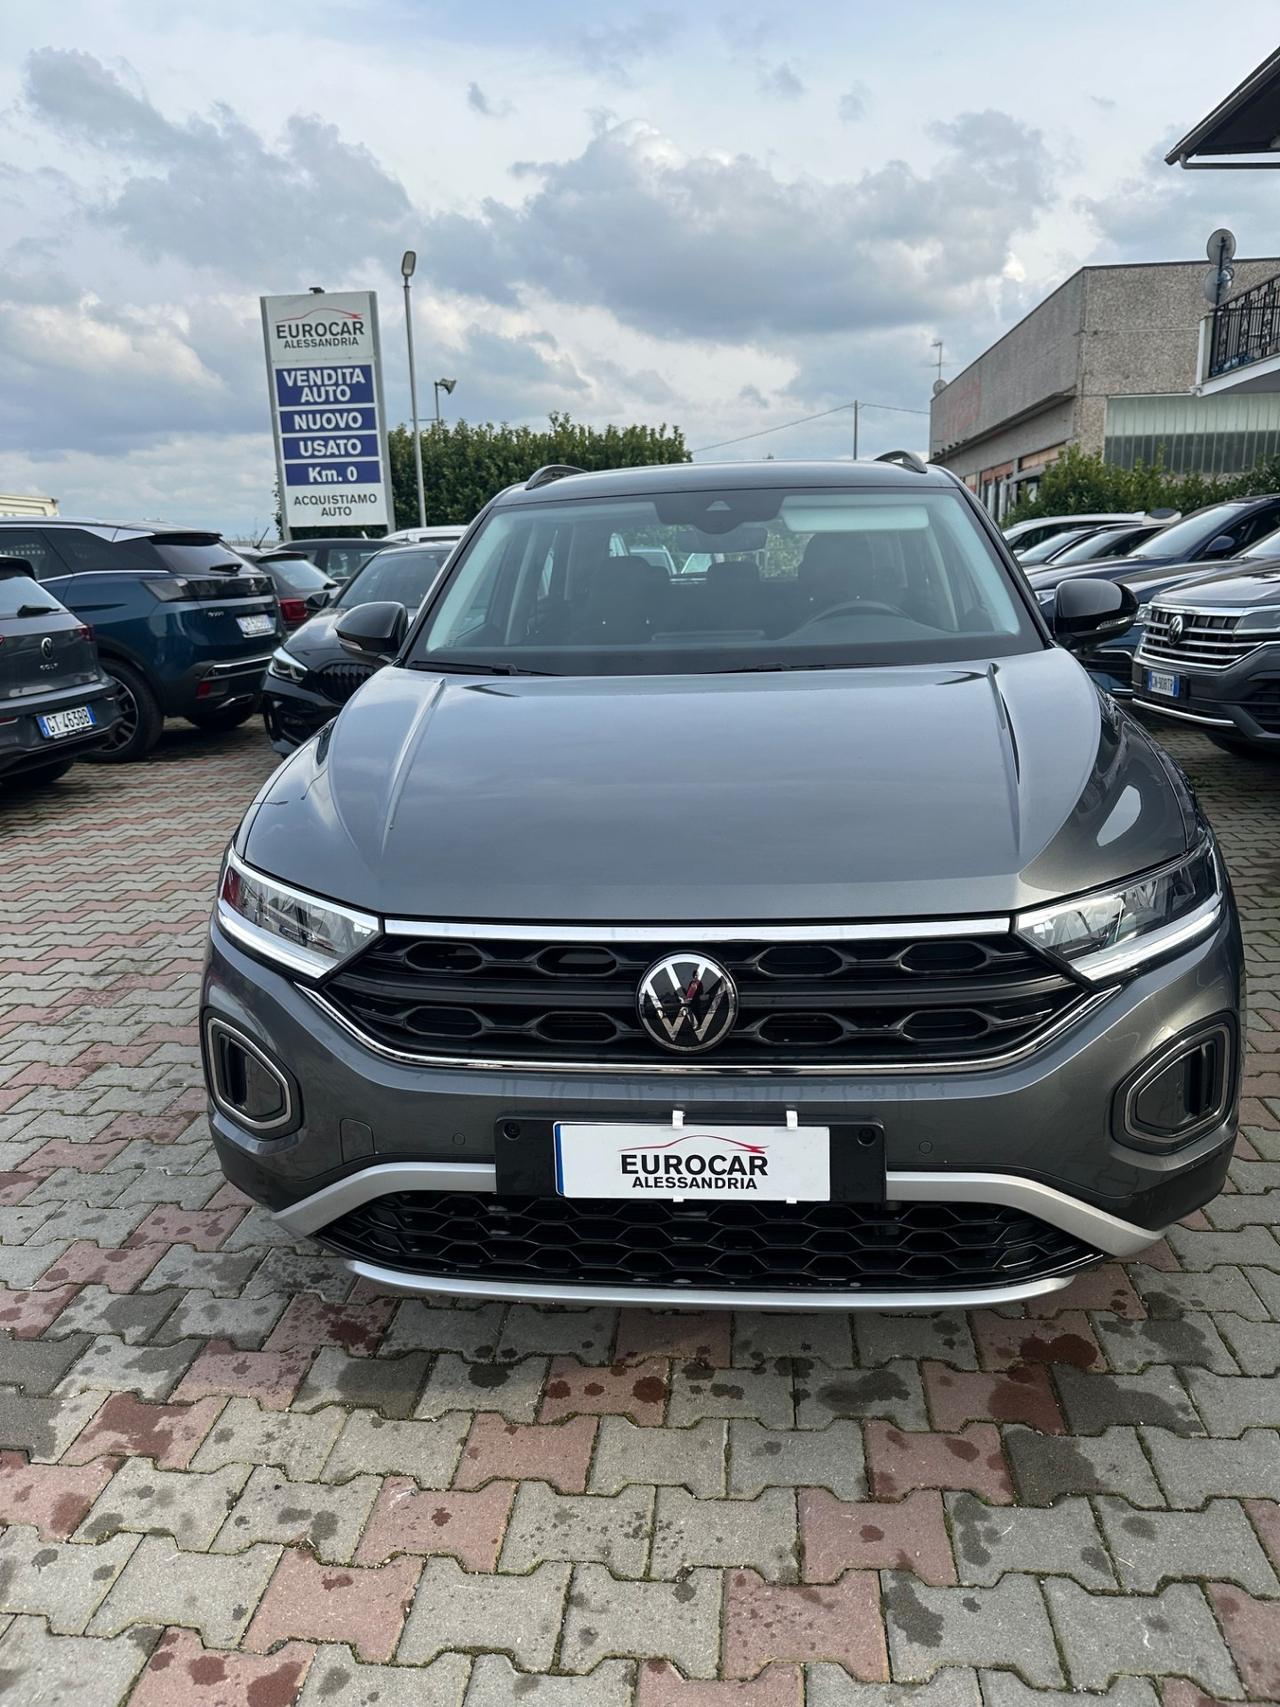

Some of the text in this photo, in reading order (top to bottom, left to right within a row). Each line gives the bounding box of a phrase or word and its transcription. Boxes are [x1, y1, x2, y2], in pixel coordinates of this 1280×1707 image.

[276, 321, 365, 339] EUROCAR
[284, 337, 360, 349] ALESSANDRIA
[283, 368, 366, 387] VENDITA
[301, 385, 351, 403] AUTO
[293, 412, 363, 430] NUOVO
[299, 438, 362, 456] USATO
[308, 466, 358, 483] Km. 0
[294, 494, 378, 506] ACQUISTIAMO
[321, 506, 352, 517] AUTO
[621, 1154, 769, 1176] EUROCAR
[632, 1176, 758, 1190] ALESSANDRIA
